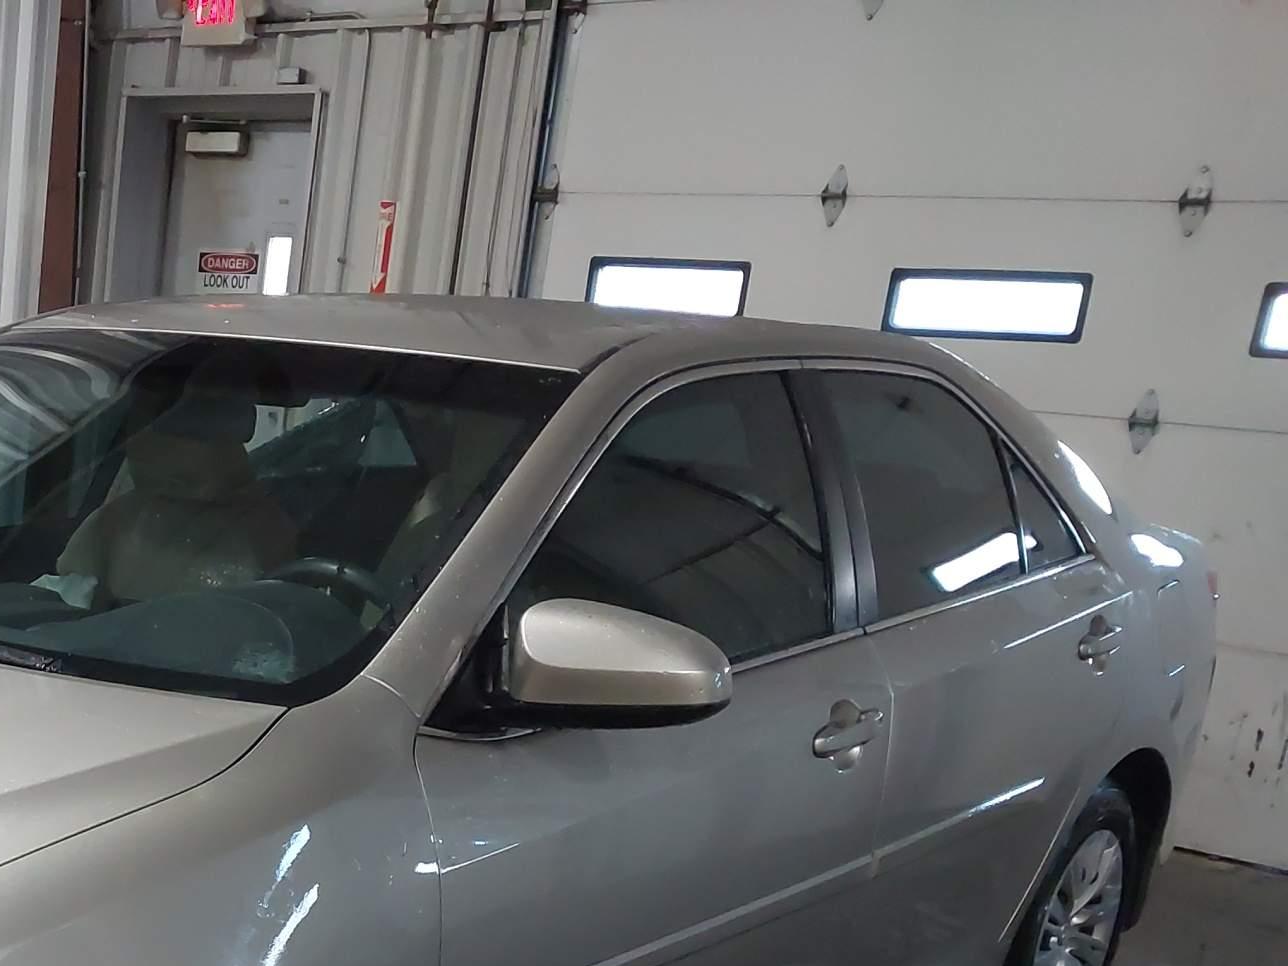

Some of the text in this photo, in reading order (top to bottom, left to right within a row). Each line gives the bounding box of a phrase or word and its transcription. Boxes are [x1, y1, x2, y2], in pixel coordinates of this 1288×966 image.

[207, 257, 249, 269] DANGER
[203, 273, 250, 289] LOOK OUT
